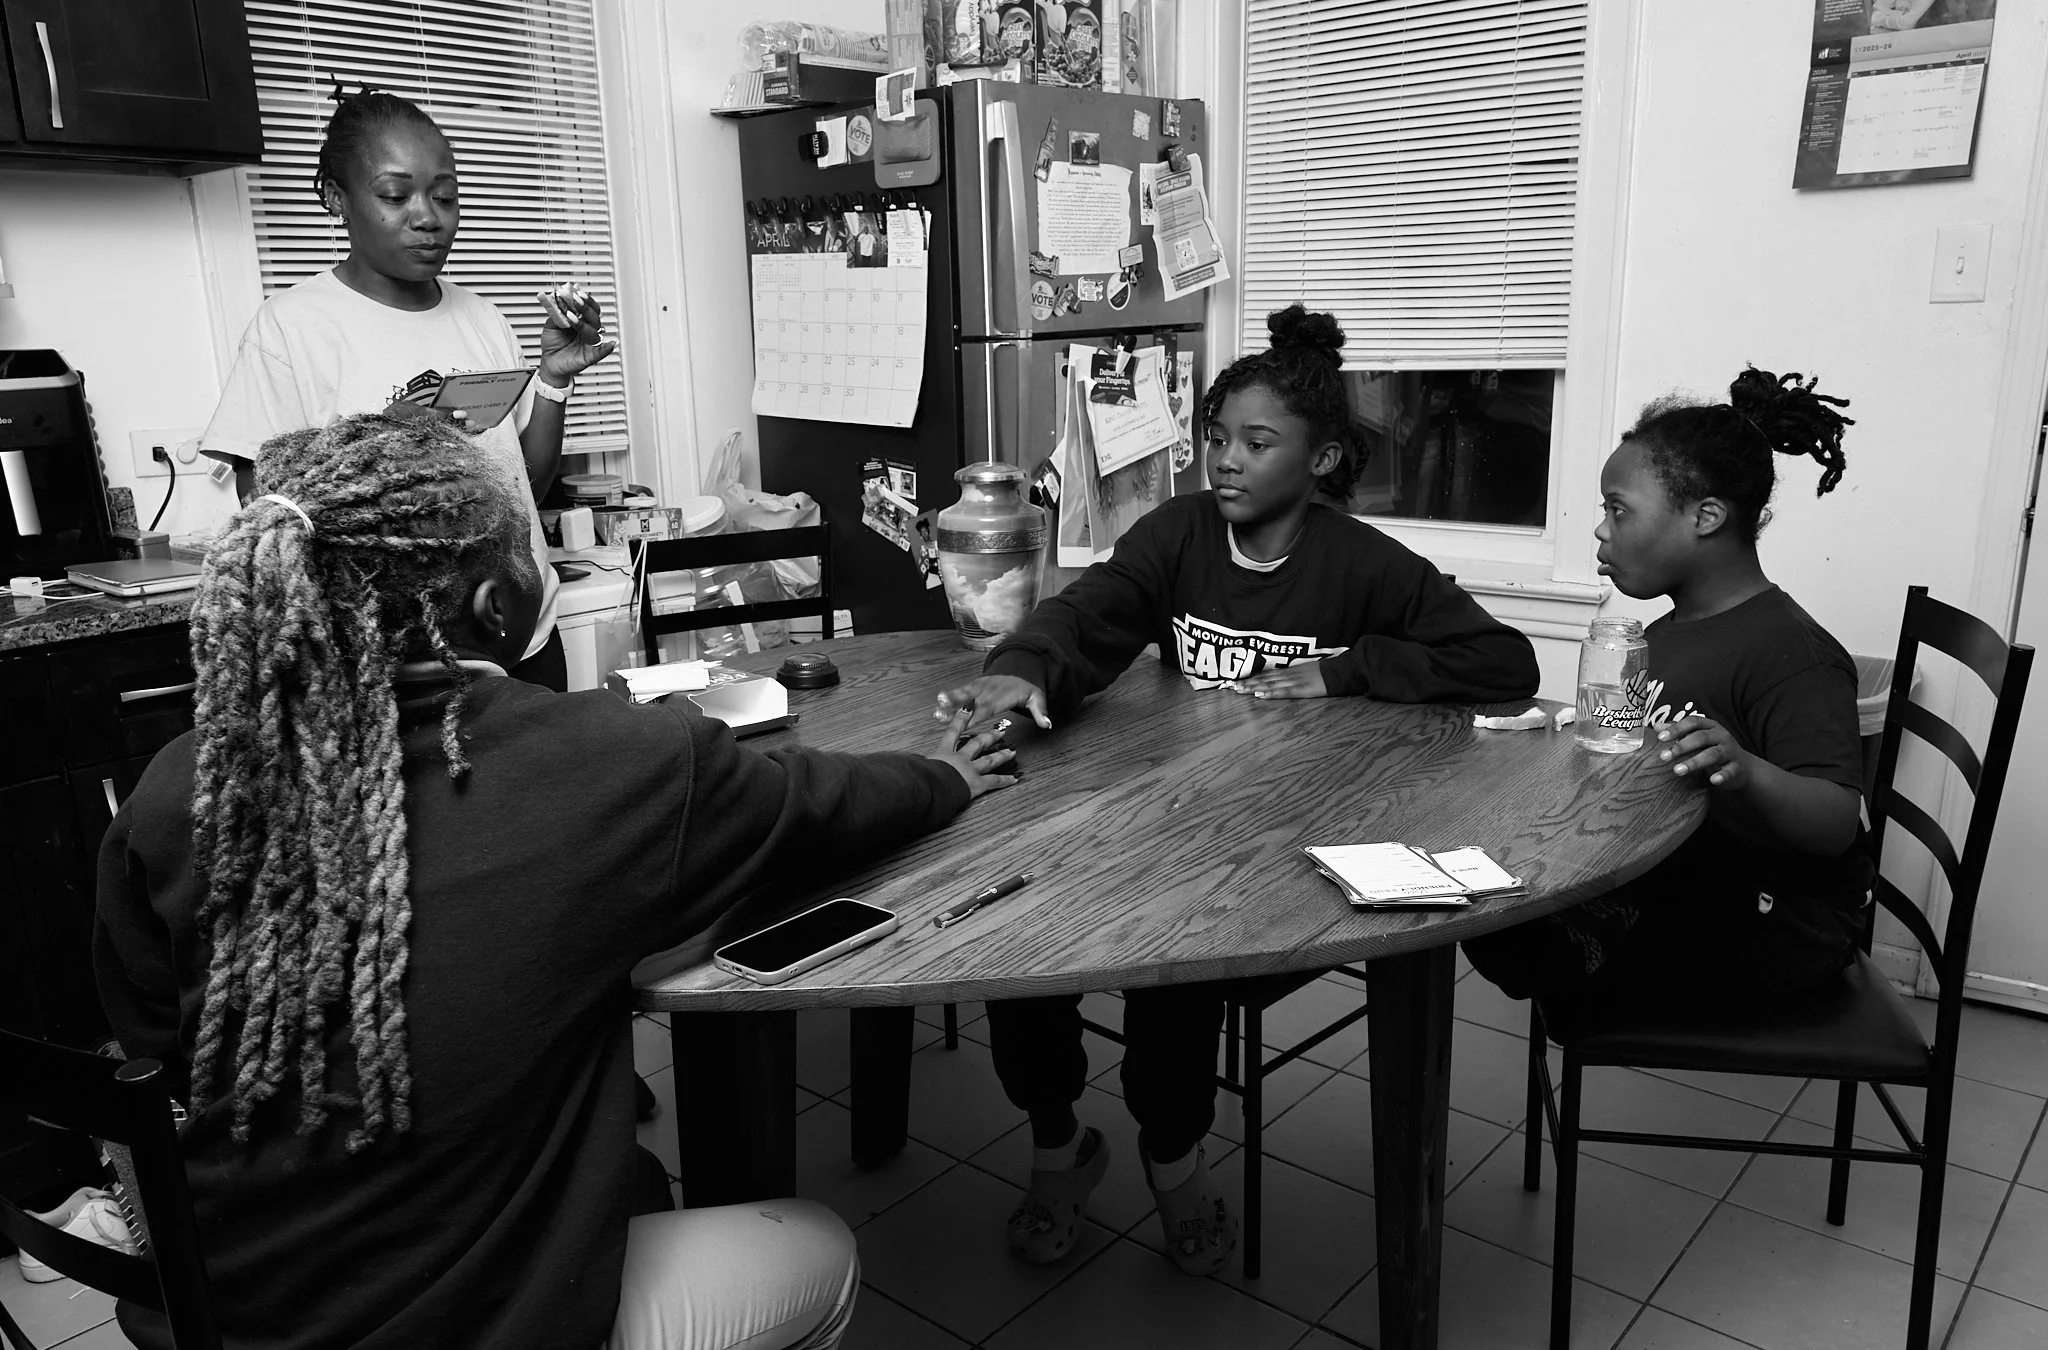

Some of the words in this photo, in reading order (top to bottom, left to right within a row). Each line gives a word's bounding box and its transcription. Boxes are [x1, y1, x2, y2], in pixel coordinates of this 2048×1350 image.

[850, 125, 871, 144] VOTE
[757, 232, 790, 248] APRIL
[1031, 293, 1053, 307] VOTE
[1191, 627, 1244, 647] MOVING
[1249, 637, 1303, 655] EVEREST
[1178, 628, 1322, 680] EAGL
